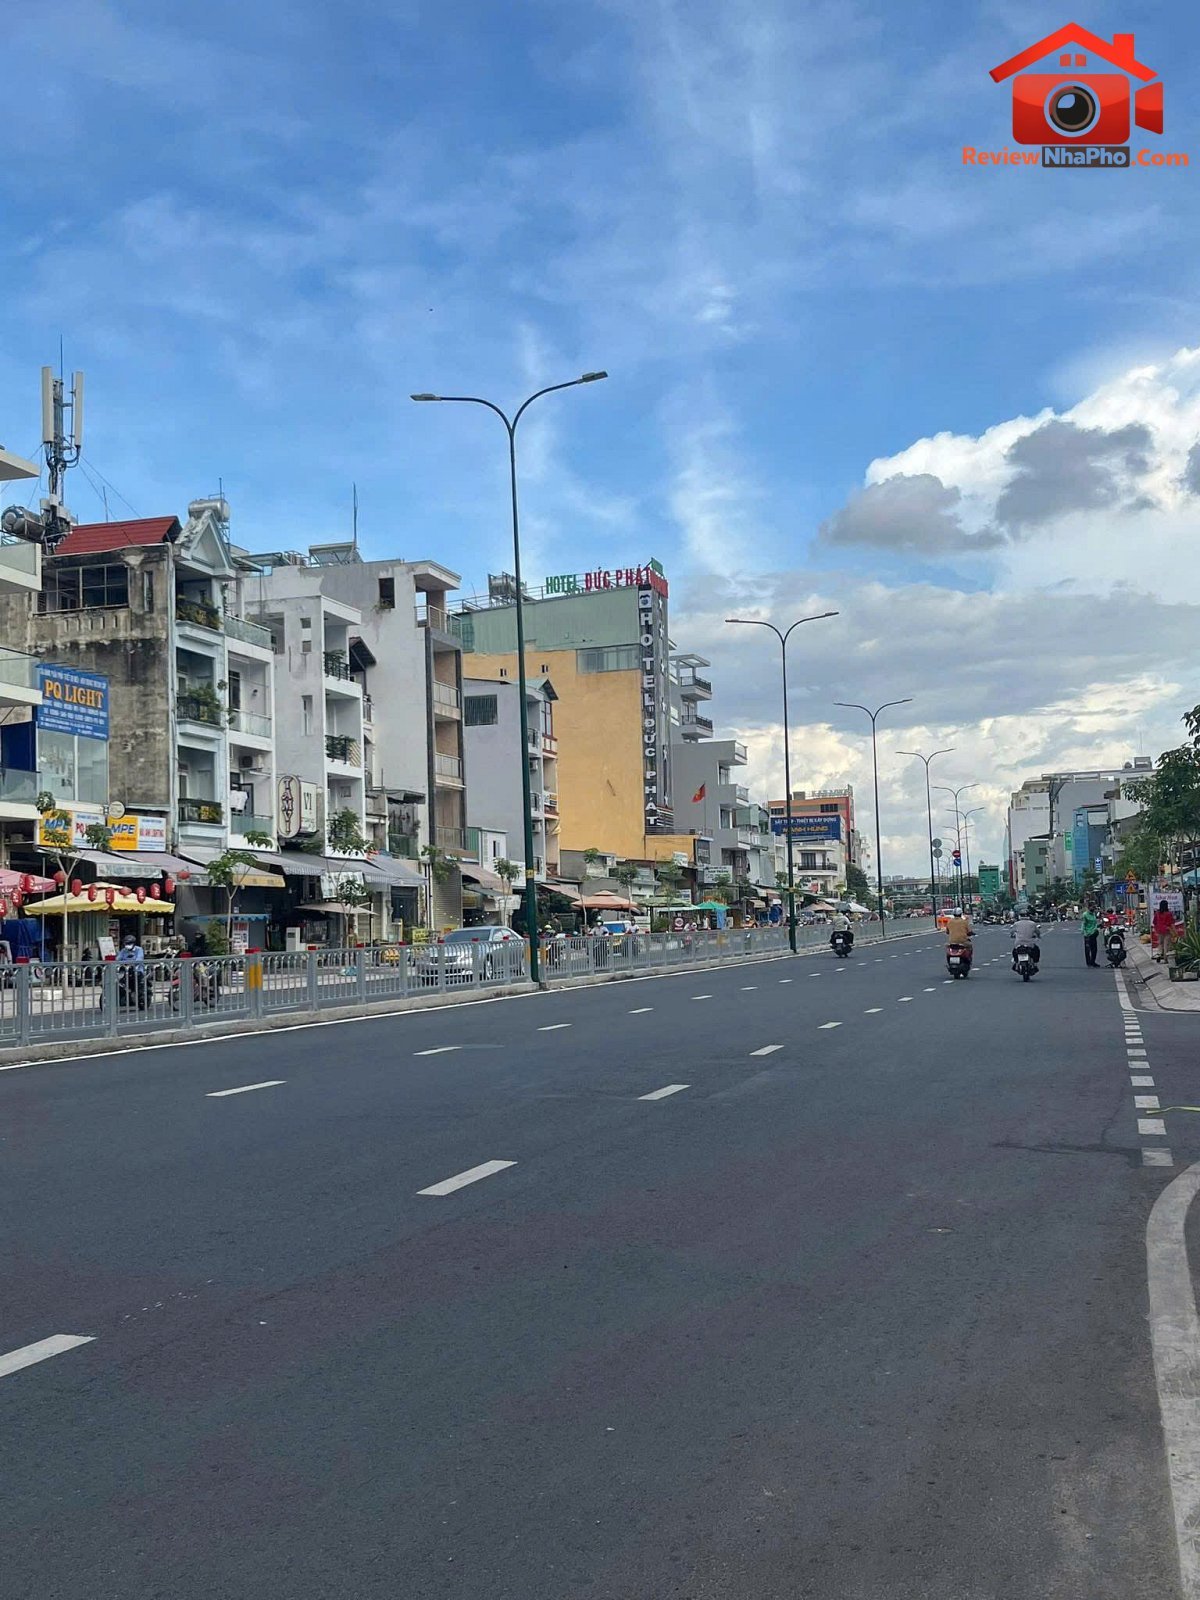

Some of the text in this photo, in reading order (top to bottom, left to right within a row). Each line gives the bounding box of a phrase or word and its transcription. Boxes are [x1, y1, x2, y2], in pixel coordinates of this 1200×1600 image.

[545, 574, 577, 595] HOTEL
[585, 566, 611, 590] ĐỨC
[615, 564, 651, 586] PHÁT
[45, 679, 62, 700] PQ
[64, 683, 104, 709] LIGHT
[645, 770, 658, 825] PHÁT
[111, 823, 136, 836] MPE
